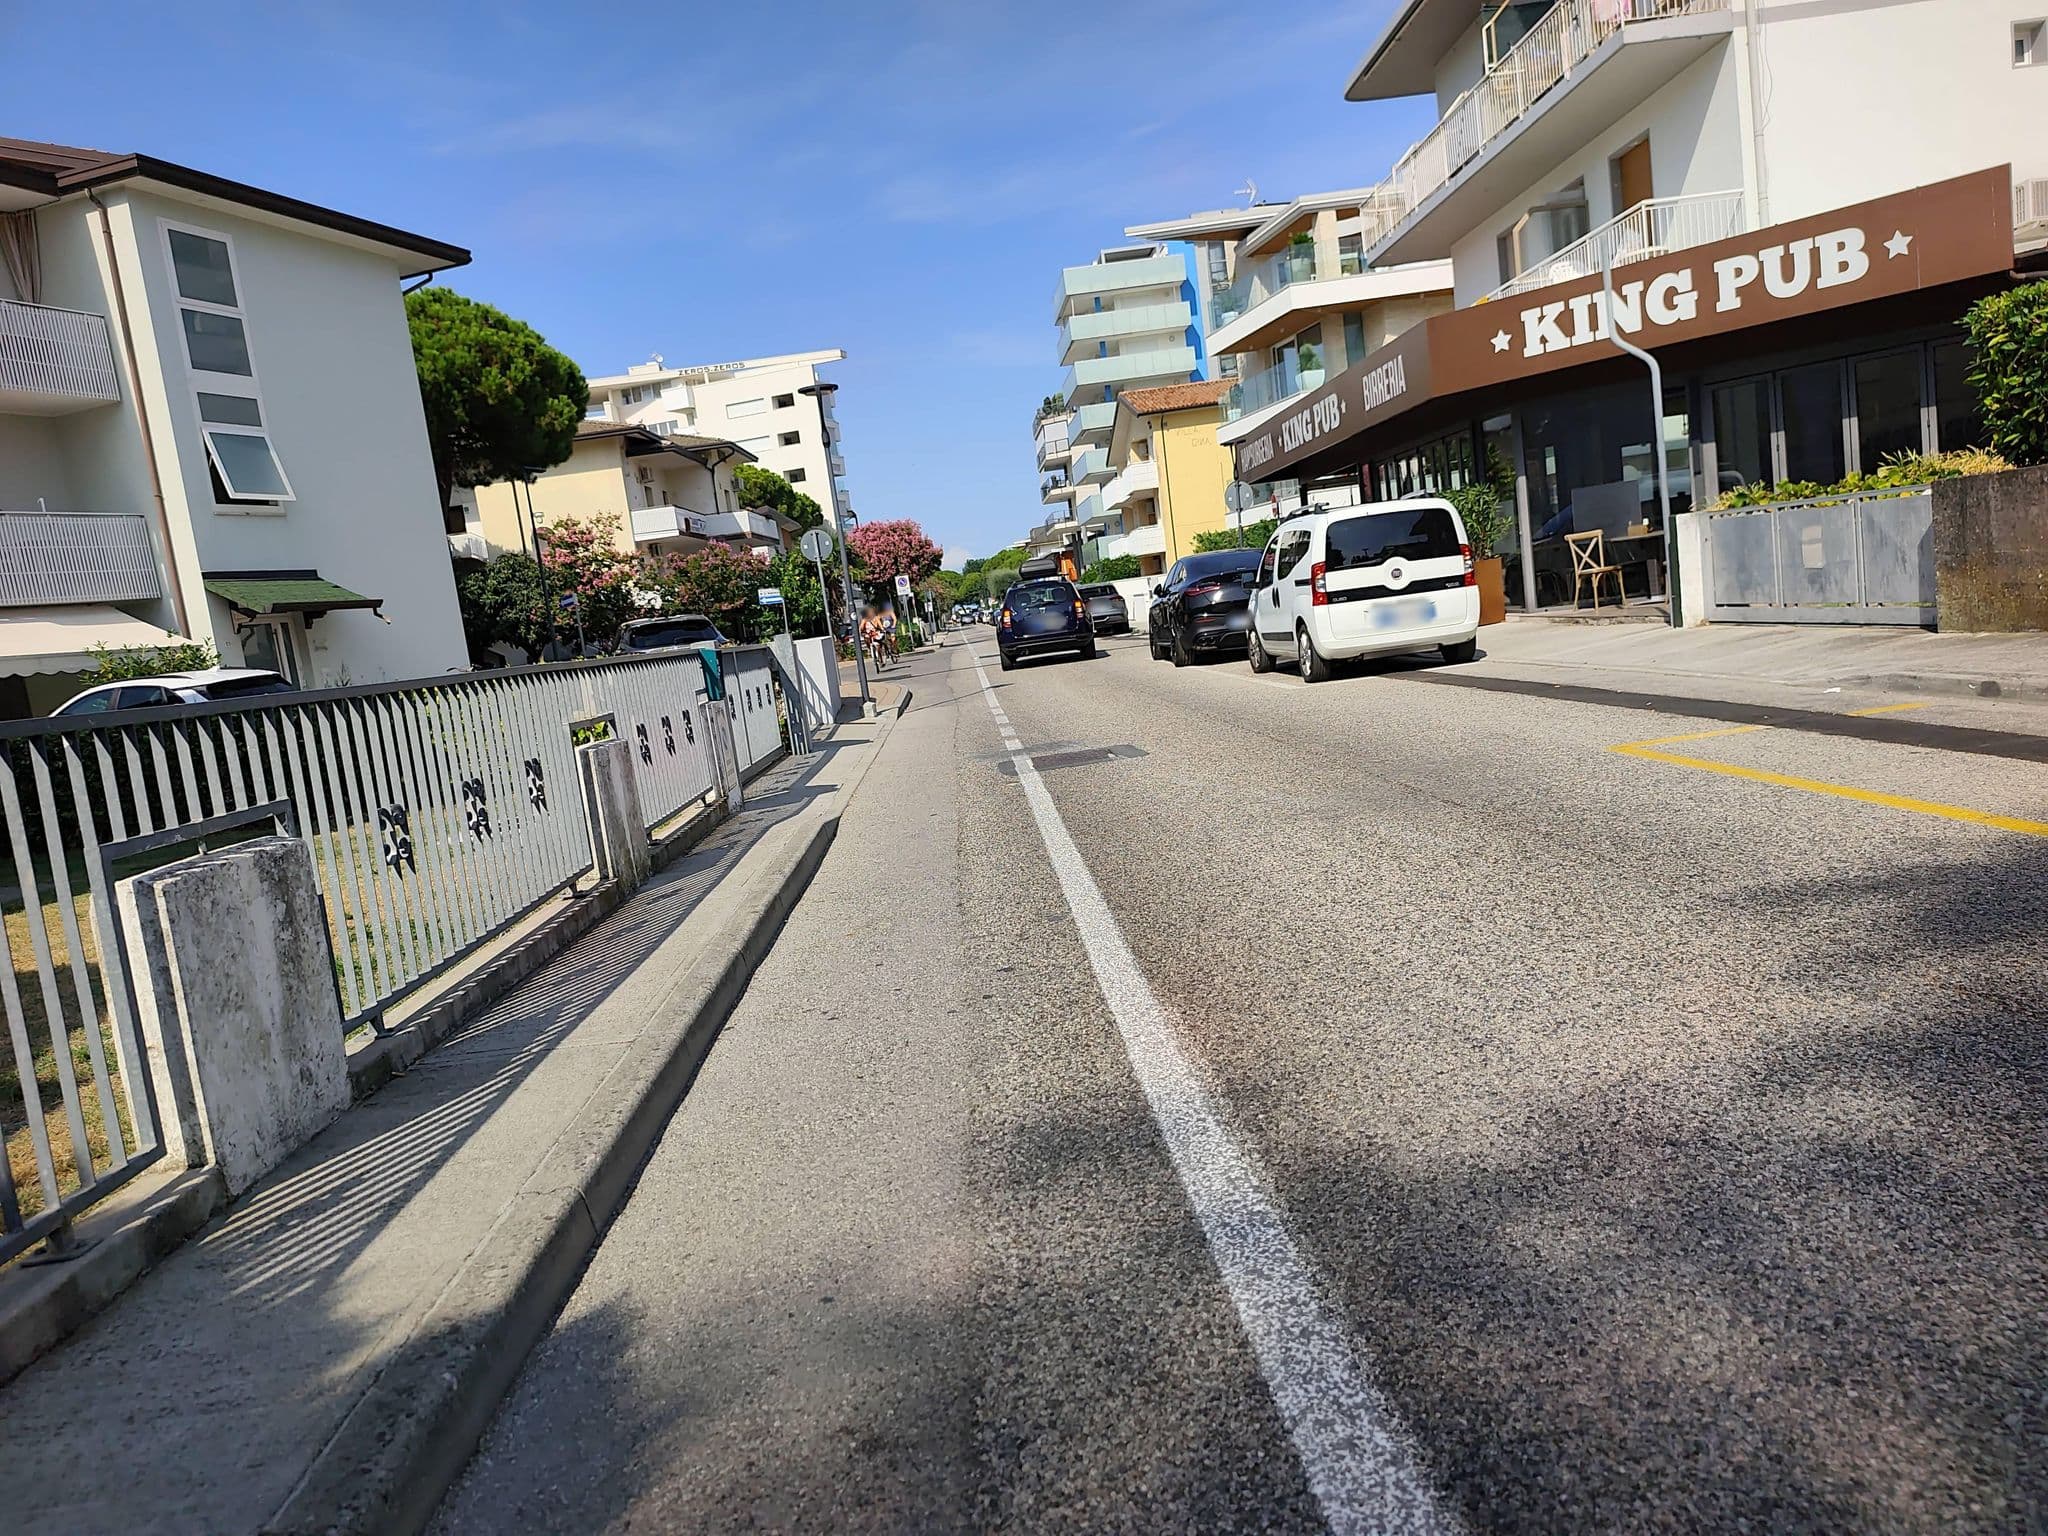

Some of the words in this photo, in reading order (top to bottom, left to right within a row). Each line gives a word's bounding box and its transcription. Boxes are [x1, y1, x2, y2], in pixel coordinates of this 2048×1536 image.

[1520, 268, 1698, 358] KING
[1713, 227, 1870, 313] PUB
[1362, 354, 1407, 411] BIRRERIA
[1281, 408, 1313, 453] KING
[1312, 393, 1341, 437] PUB
